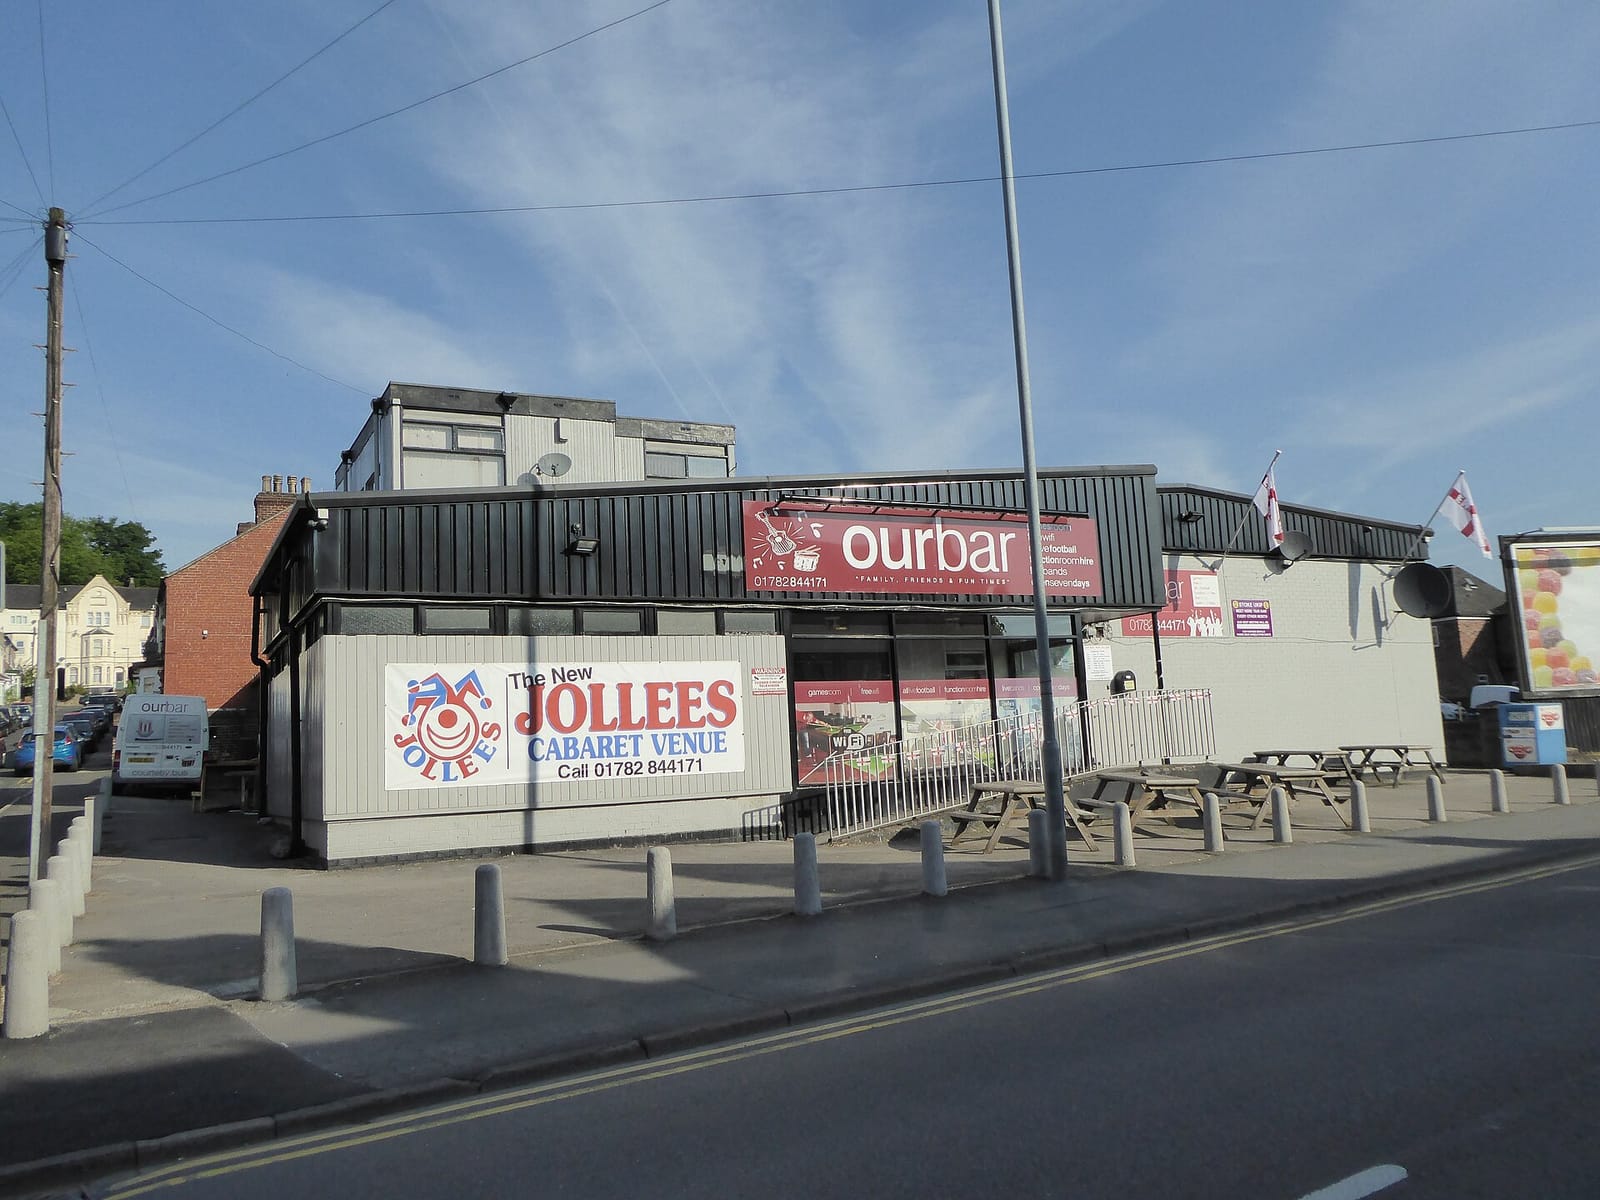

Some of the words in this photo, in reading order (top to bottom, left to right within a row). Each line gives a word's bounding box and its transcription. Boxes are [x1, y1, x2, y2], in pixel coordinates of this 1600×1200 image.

[843, 517, 1016, 573] ourbar
[754, 576, 828, 588] 01782844171
[904, 576, 944, 584] FRIENDS
[508, 672, 546, 690] The
[551, 666, 593, 684] New
[141, 701, 189, 712] ourbar
[514, 679, 737, 735] JOLLEES
[527, 734, 643, 762] CABARET
[651, 731, 728, 756] VENUE
[557, 763, 589, 779] Call
[594, 761, 643, 777] 01782
[647, 758, 703, 775] 844171
